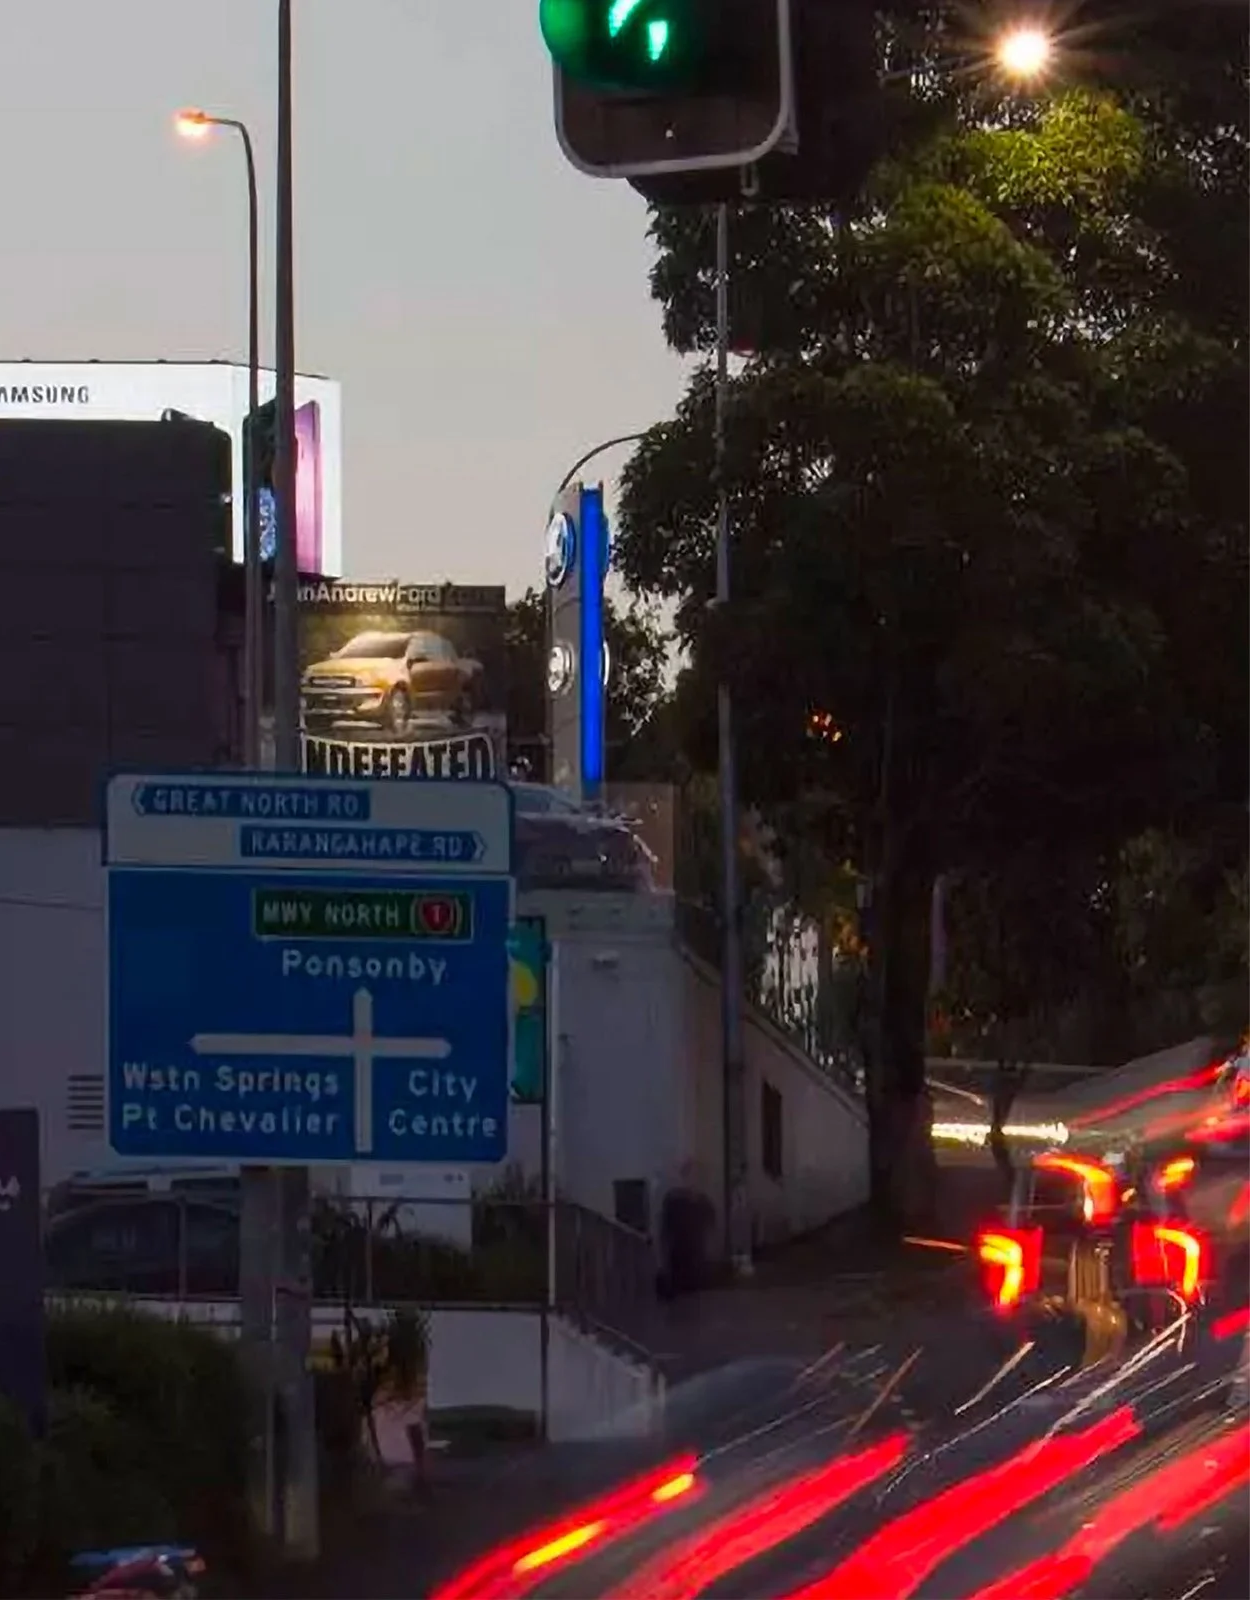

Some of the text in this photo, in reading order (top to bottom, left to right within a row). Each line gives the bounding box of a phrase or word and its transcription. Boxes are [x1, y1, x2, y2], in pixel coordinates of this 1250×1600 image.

[299, 732, 497, 778] NDEFEATED
[153, 788, 360, 817] GREAT NORTH RD
[252, 830, 463, 858] KARANGAHAPE RD
[262, 899, 313, 925] MWY
[325, 899, 400, 927] NORTH
[282, 948, 447, 986] Ponsonby
[122, 1062, 340, 1101] Wstn Springs
[408, 1069, 478, 1103] City
[121, 1103, 340, 1136] Pt Chevalier
[388, 1108, 498, 1138] Centre
